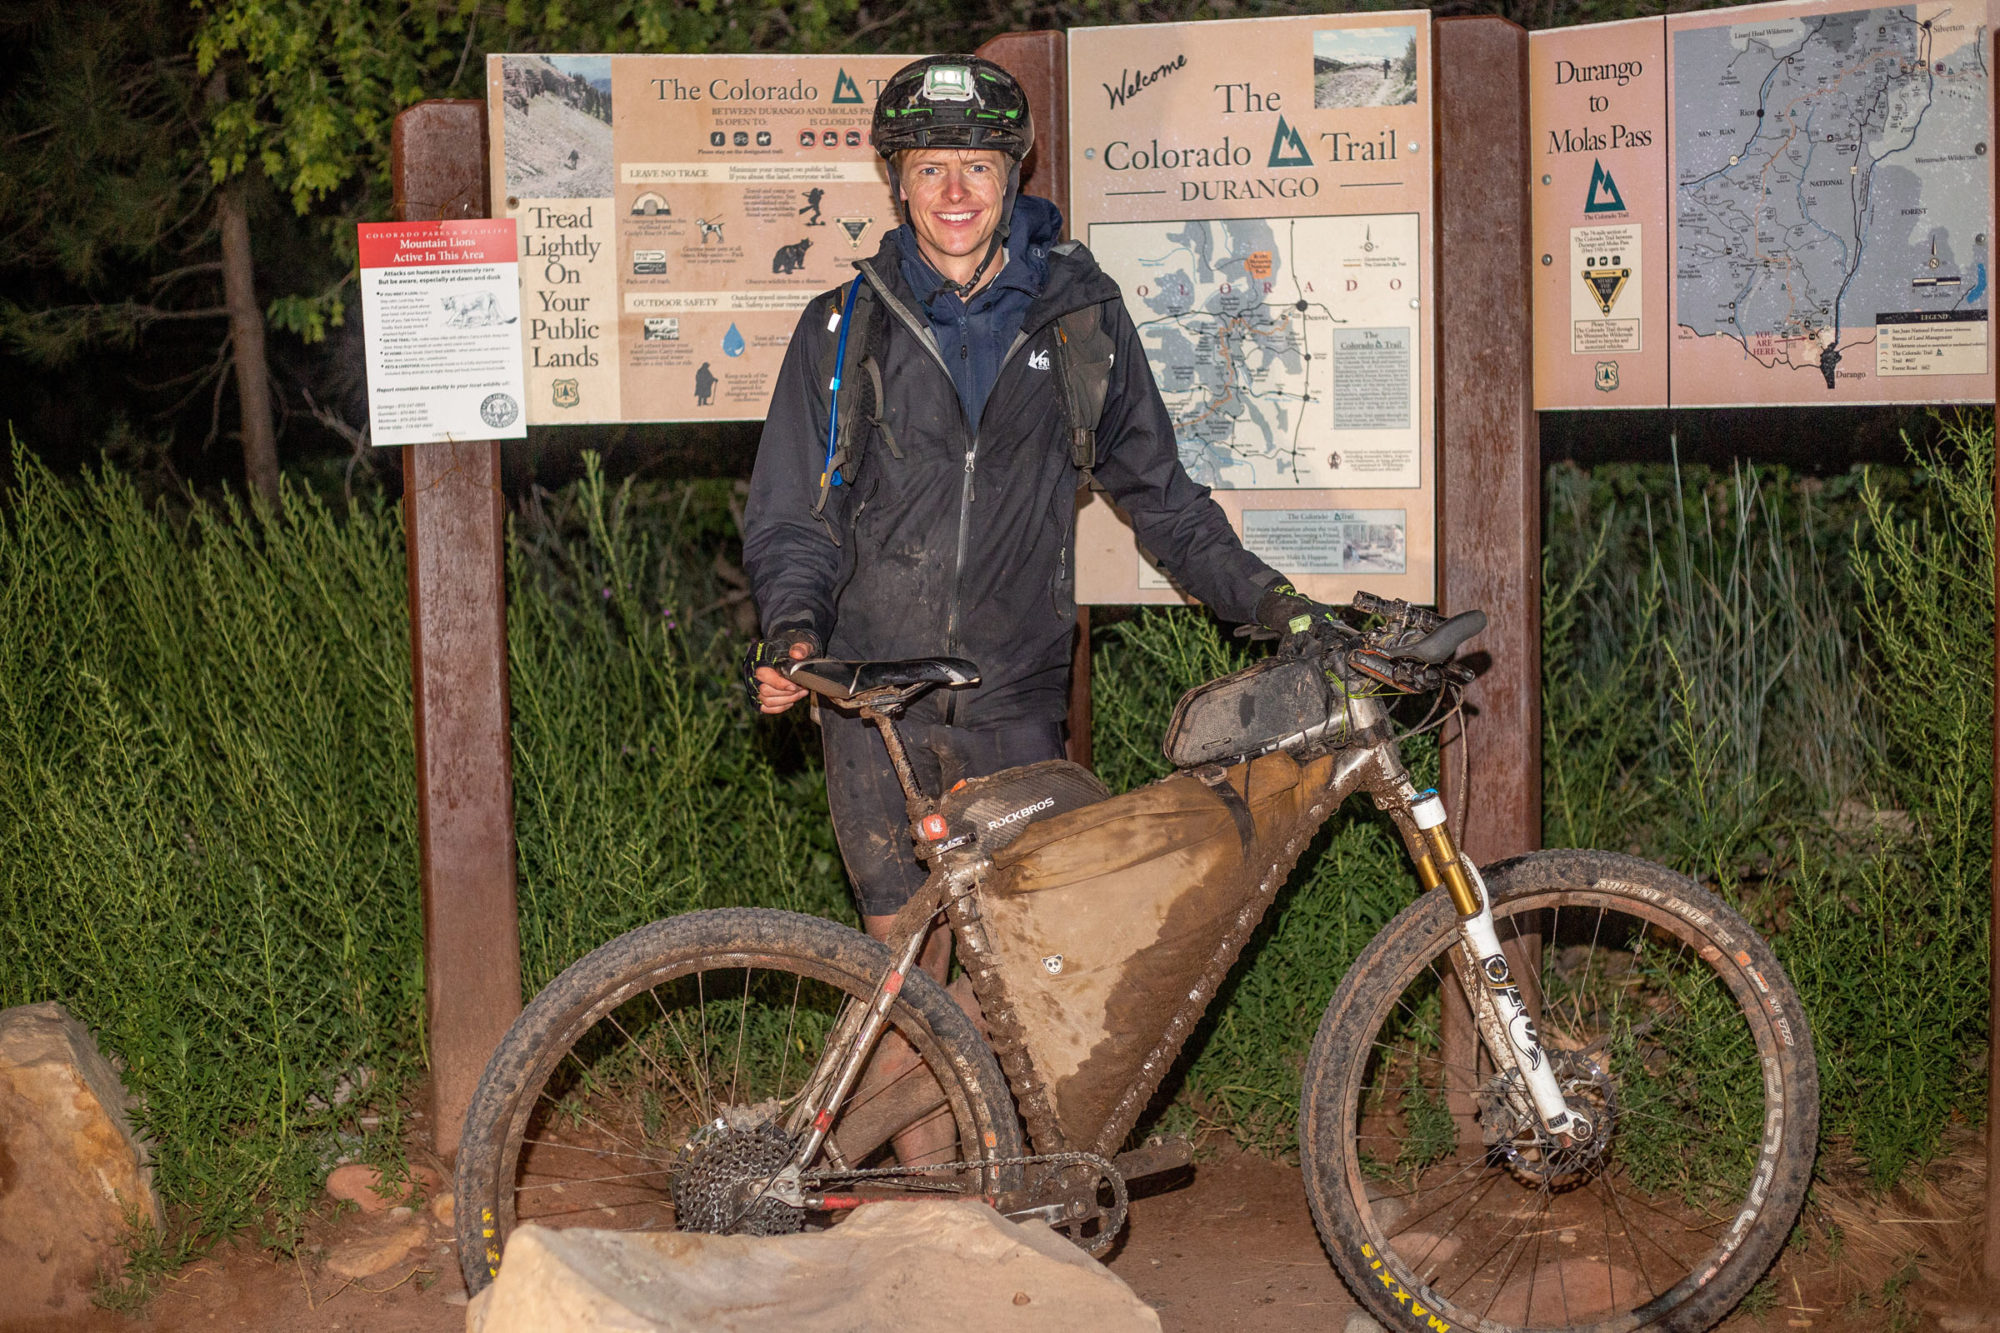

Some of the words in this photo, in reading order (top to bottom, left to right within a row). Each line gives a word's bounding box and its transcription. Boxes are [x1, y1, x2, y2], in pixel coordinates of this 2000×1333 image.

[1102, 53, 1188, 110] Welcome
[1554, 60, 1643, 86] Durango
[651, 78, 701, 101] The
[709, 78, 818, 101] Colorado
[1213, 82, 1282, 114] The
[1588, 94, 1609, 112] to
[716, 118, 722, 126] IS
[723, 118, 750, 126] OPEN
[810, 118, 817, 126] IS
[818, 118, 857, 126] CLOSED
[1546, 126, 1607, 154] Molas
[1610, 124, 1652, 150] Pass
[1104, 136, 1251, 171] Colorado
[1320, 130, 1398, 163] Trail
[630, 170, 660, 178] LEAVE
[660, 170, 676, 178] NO
[678, 170, 710, 178] TRACE
[1810, 179, 1844, 188] NATIONAL
[1180, 177, 1320, 202] DURANGO
[528, 206, 593, 228] Tread
[1901, 208, 1928, 216] FOREST
[400, 238, 447, 250] Mountain
[450, 237, 476, 247] Lions
[522, 234, 602, 264] Lightly
[393, 252, 424, 263] Active
[426, 252, 436, 262] In
[438, 252, 459, 261] This
[462, 250, 484, 260] Area
[378, 278, 388, 286] But
[420, 276, 448, 284] especially
[452, 267, 482, 276] extremely
[544, 262, 582, 284] On
[536, 291, 590, 312] Your
[633, 299, 682, 308] OUTDOOR
[684, 298, 718, 307] SAFETY
[530, 318, 600, 340] Public
[532, 346, 600, 368] Lands
[1836, 370, 1866, 380] Durango
[988, 797, 1054, 830] ROCKBROS
[1360, 1242, 1450, 1333] MAXXIS
